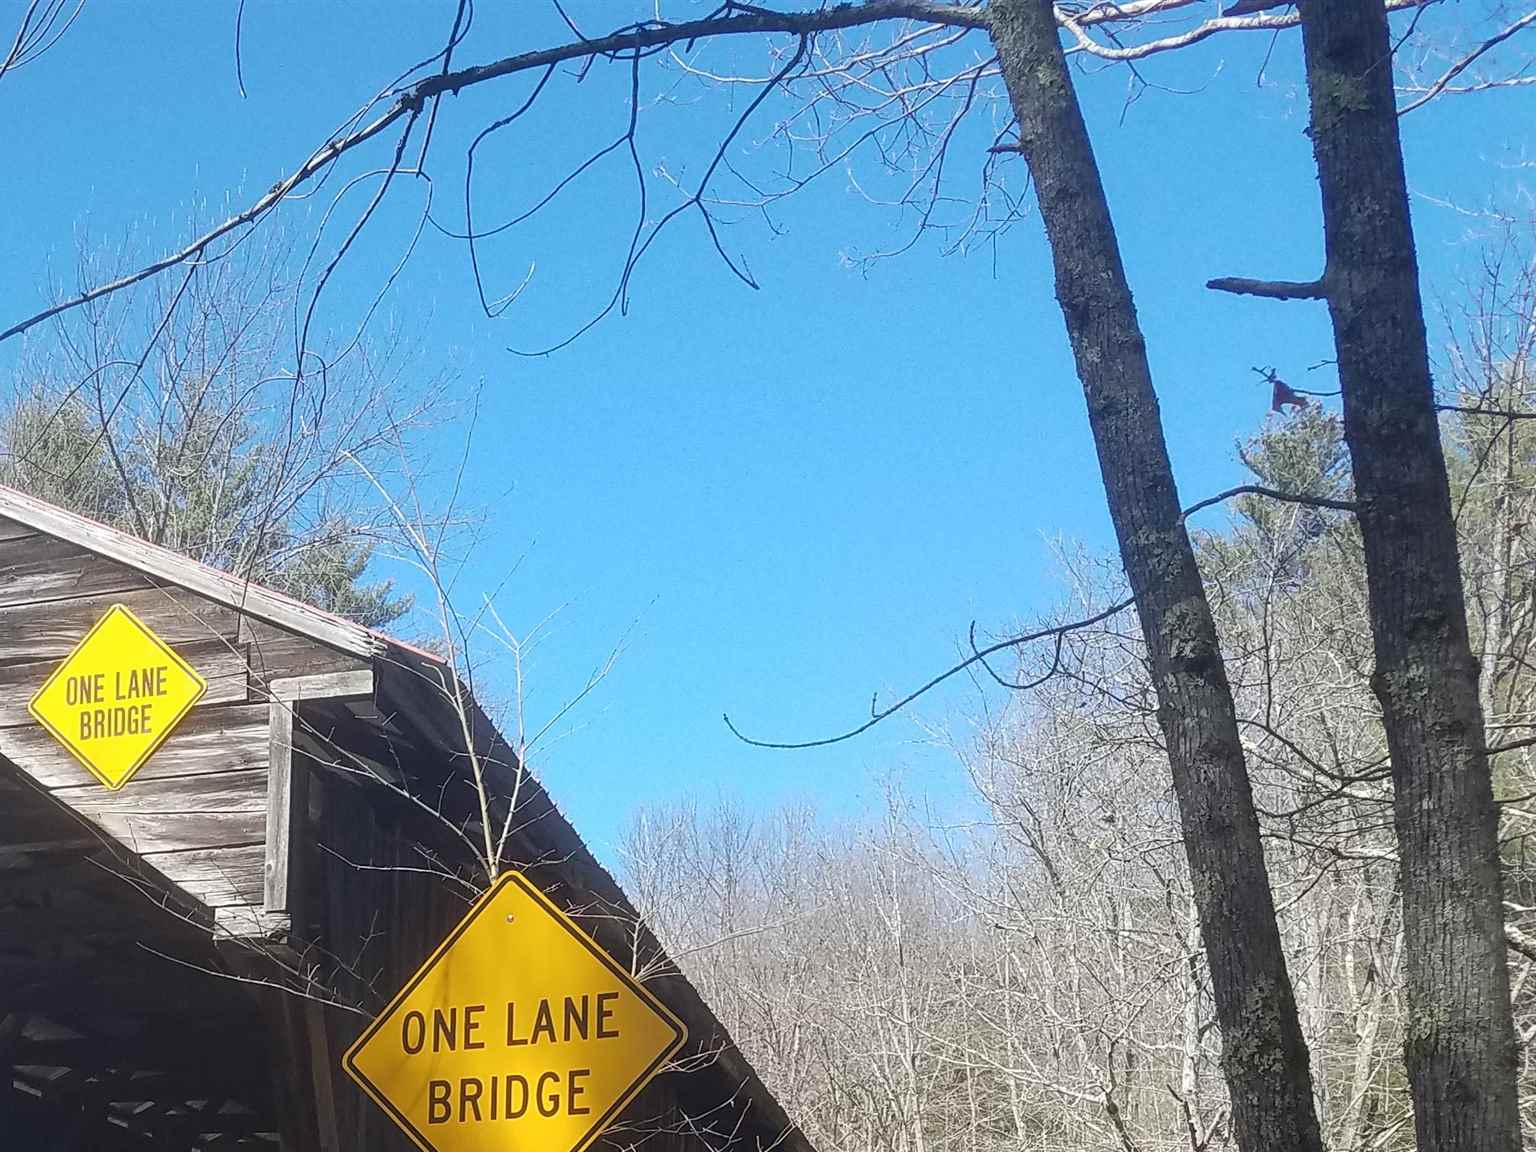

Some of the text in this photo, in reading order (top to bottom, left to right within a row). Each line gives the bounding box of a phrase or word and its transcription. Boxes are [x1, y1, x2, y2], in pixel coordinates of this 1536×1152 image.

[66, 666, 168, 706] ONE LANE
[79, 704, 152, 741] BRIDGE
[401, 992, 620, 1055] ONE LANE
[428, 1069, 590, 1124] BRIDGE
